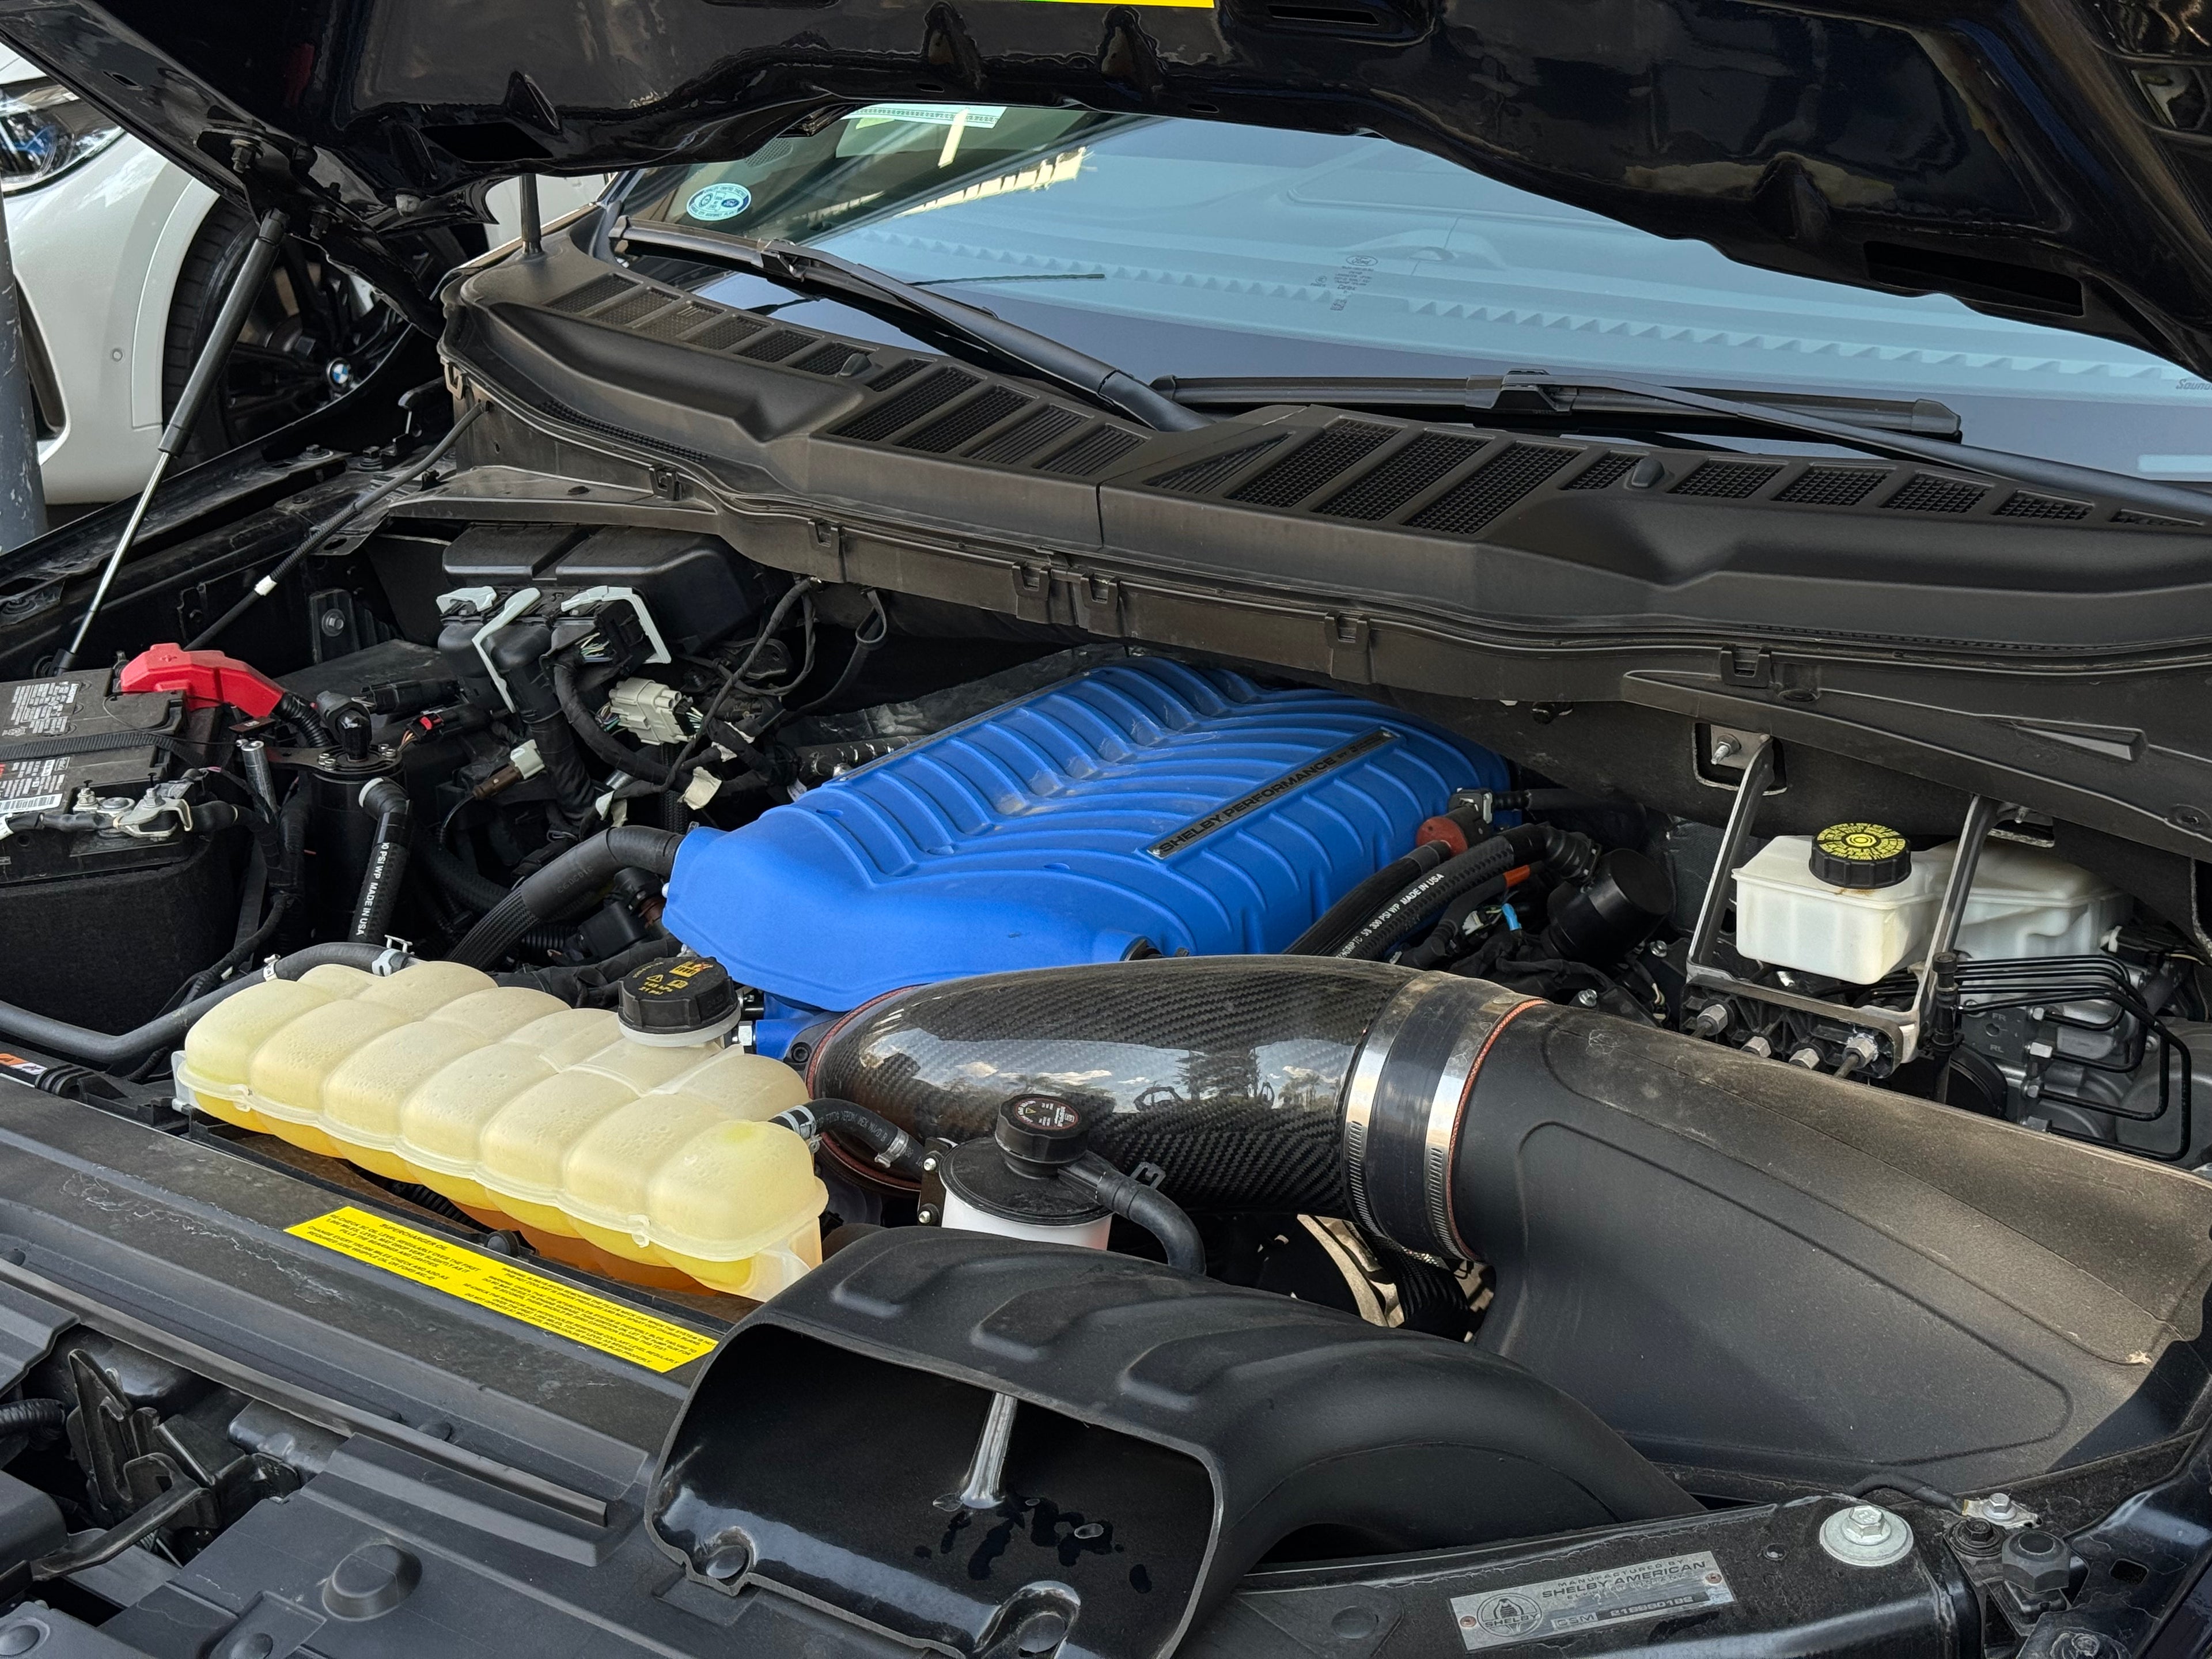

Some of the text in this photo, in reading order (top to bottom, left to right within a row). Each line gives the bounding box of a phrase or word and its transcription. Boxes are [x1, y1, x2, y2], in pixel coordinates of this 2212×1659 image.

[1158, 813, 1222, 853] SHELBY
[1224, 756, 1336, 818] PERFORMANCE
[377, 851, 388, 864] PSI
[373, 865, 384, 880] WP
[365, 882, 378, 907] MADE
[1369, 919, 1382, 930] 300
[1378, 912, 1392, 922] PSI
[1388, 903, 1401, 914] WP
[1400, 889, 1422, 905] MADE
[1418, 882, 1429, 892] IN
[1426, 873, 1445, 885] USA
[361, 907, 372, 916] IN
[355, 916, 368, 936] USA
[1992, 1013, 2007, 1021] FR
[1990, 1044, 2005, 1053] RL
[379, 1224, 437, 1247] SUPERCHARGER
[1541, 1561, 1706, 1598] SHELBY AMERICAN
[1558, 1563, 1662, 1588] MANUFACTURED
[1485, 1612, 1538, 1628] SHELBY
[1557, 1614, 1595, 1627] CSM
